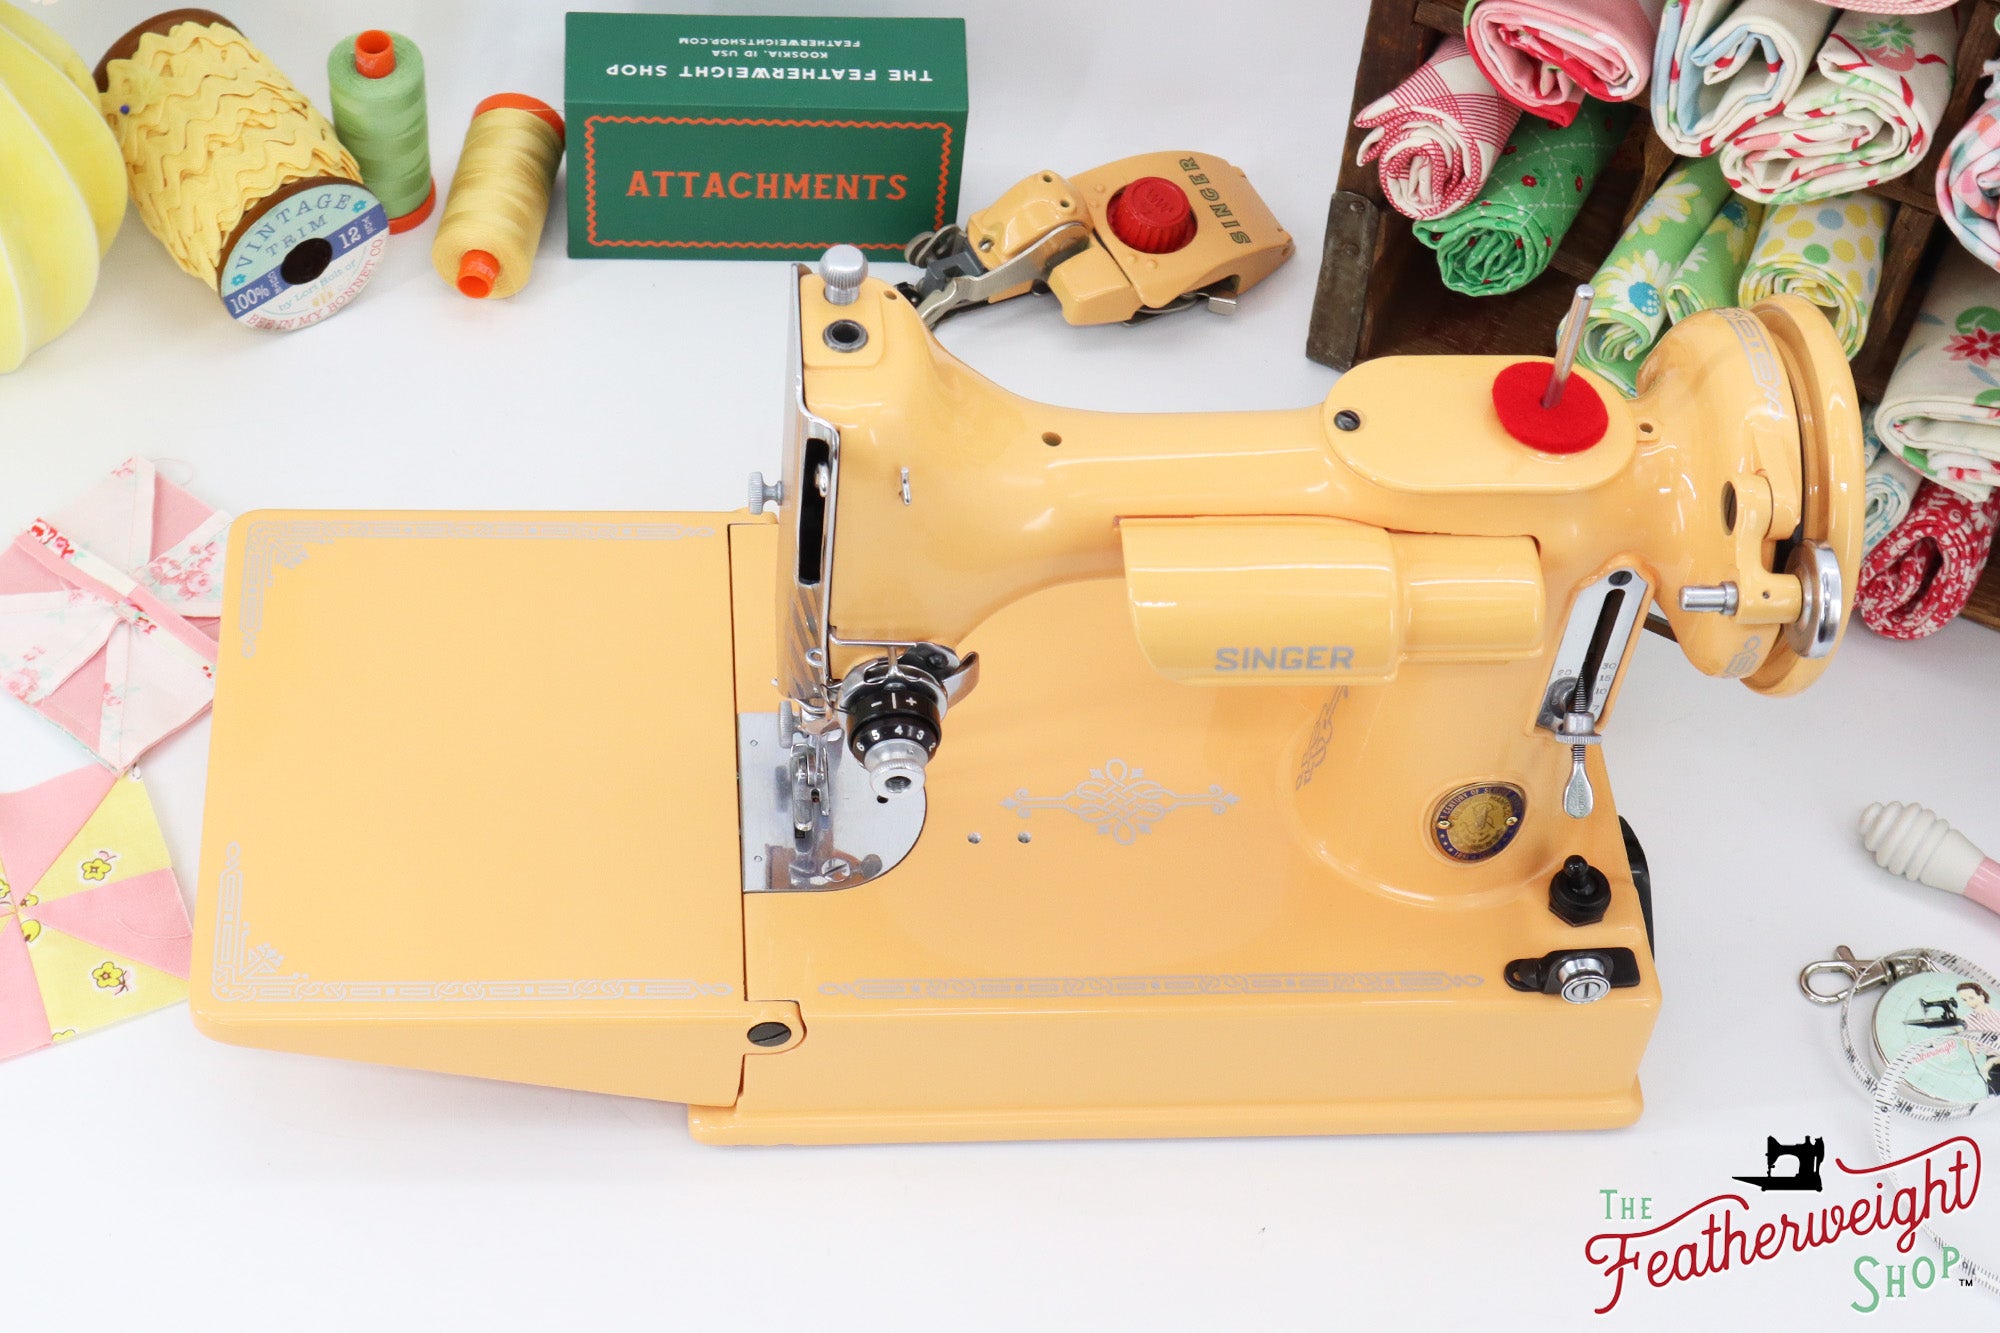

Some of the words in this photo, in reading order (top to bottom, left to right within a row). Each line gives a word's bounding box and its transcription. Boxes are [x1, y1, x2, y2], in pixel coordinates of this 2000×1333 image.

[678, 37, 861, 48] FEATHERWEIGHTSHOP.COM
[711, 49, 738, 58] USA
[742, 50, 758, 59] ID
[605, 63, 668, 78] SHOP
[679, 66, 876, 81] FEATHERWEIGHT
[888, 69, 933, 82] THE
[625, 170, 909, 201] ATTACHMENTS
[1179, 156, 1252, 245] SINGER
[235, 193, 352, 270] VINTAGE
[265, 215, 328, 258] TRIM
[338, 226, 362, 250] 12
[230, 285, 270, 315] 100%
[278, 298, 293, 312] by
[295, 283, 319, 302] Lori
[300, 308, 324, 327] MY
[327, 260, 376, 313] BONNET
[1213, 645, 1355, 672] SINGER
[856, 742, 866, 752] 6
[871, 729, 880, 741] 5
[894, 724, 904, 735] 4
[916, 730, 925, 741] 3
